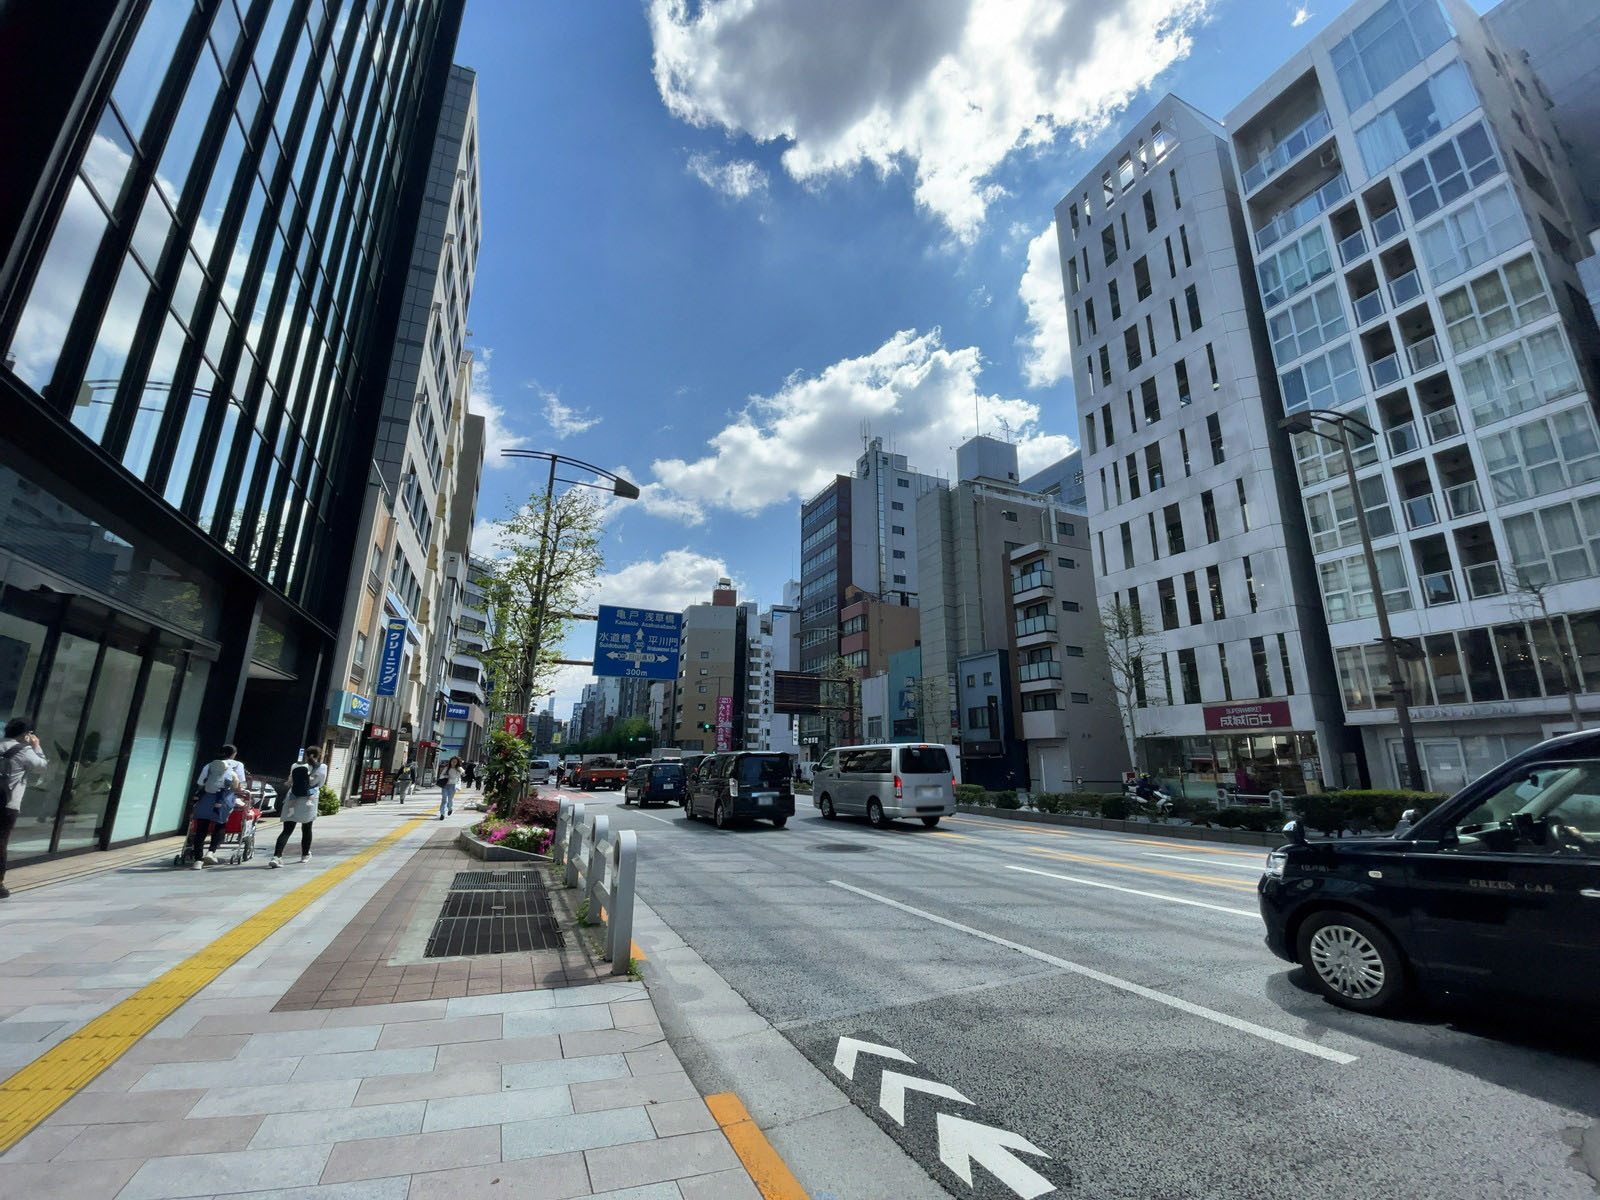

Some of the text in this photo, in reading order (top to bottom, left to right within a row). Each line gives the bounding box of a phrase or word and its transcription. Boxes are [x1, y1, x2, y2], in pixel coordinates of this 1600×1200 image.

[616, 609, 675, 624] 亀戸 浅草橋
[599, 632, 631, 643] 水道橋
[648, 635, 679, 647] 平川門
[382, 632, 401, 684] クリーニング
[625, 668, 648, 677] 300m
[1220, 713, 1272, 727] 成城石井
[1469, 878, 1515, 890] GREEN
